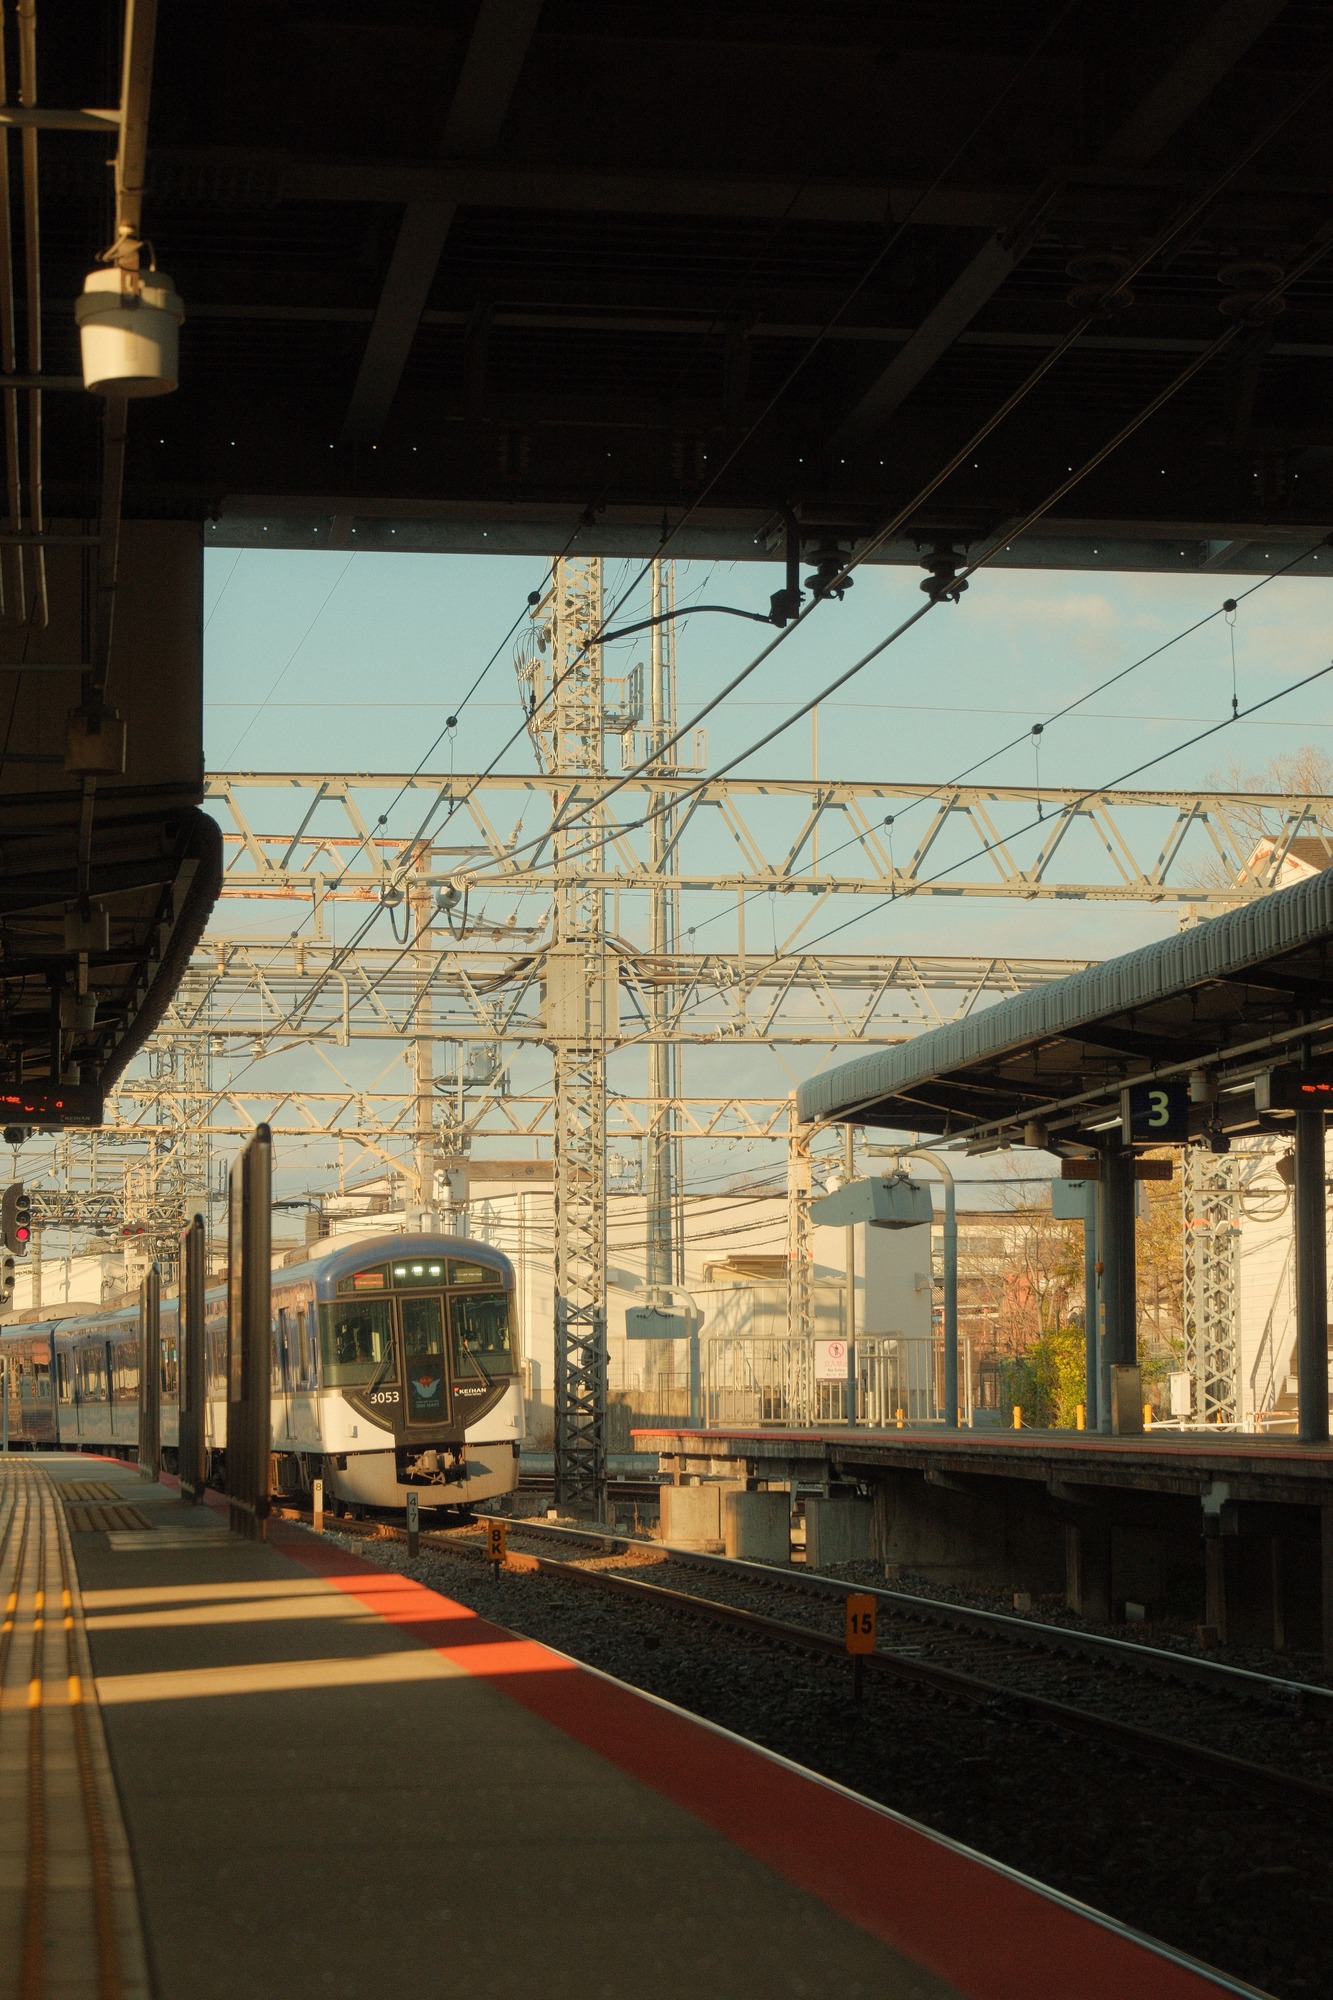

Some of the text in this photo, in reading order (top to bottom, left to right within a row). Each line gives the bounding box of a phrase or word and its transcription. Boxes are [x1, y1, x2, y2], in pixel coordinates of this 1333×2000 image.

[1148, 1091, 1170, 1127] 3
[370, 1391, 400, 1404] 3053
[459, 1387, 487, 1395] KEIHAN
[315, 1483, 322, 1491] 8
[851, 1613, 873, 1635] 15
